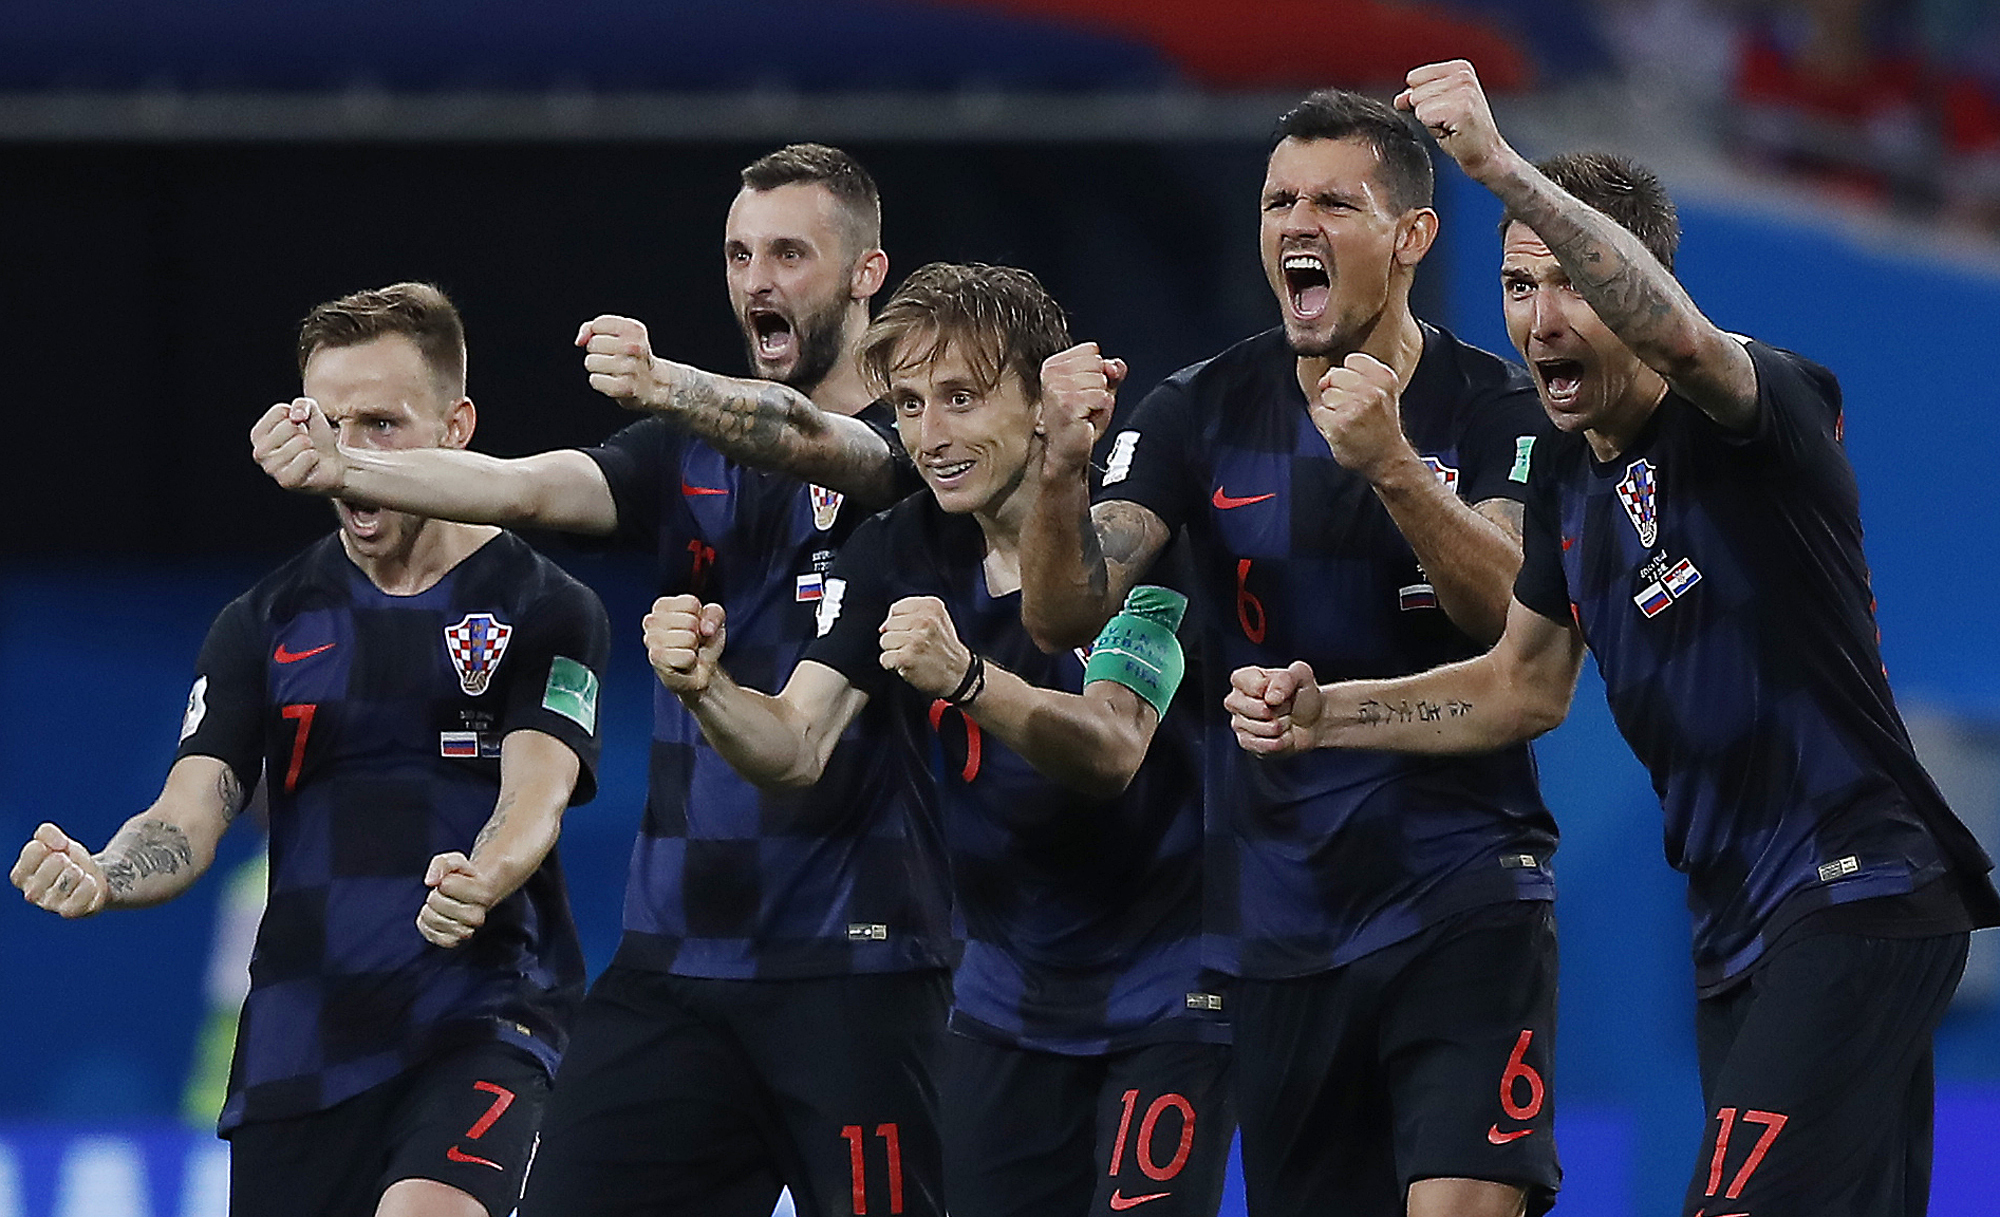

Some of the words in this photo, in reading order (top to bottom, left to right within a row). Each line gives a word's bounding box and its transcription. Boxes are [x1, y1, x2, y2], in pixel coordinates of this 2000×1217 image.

[1237, 559, 1266, 645] 6
[281, 704, 317, 794] 7
[465, 1081, 516, 1139] 7
[1500, 1029, 1545, 1120] 6
[840, 1123, 903, 1215] 11
[1109, 1089, 1196, 1181] 10
[1705, 1107, 1789, 1199] 17
